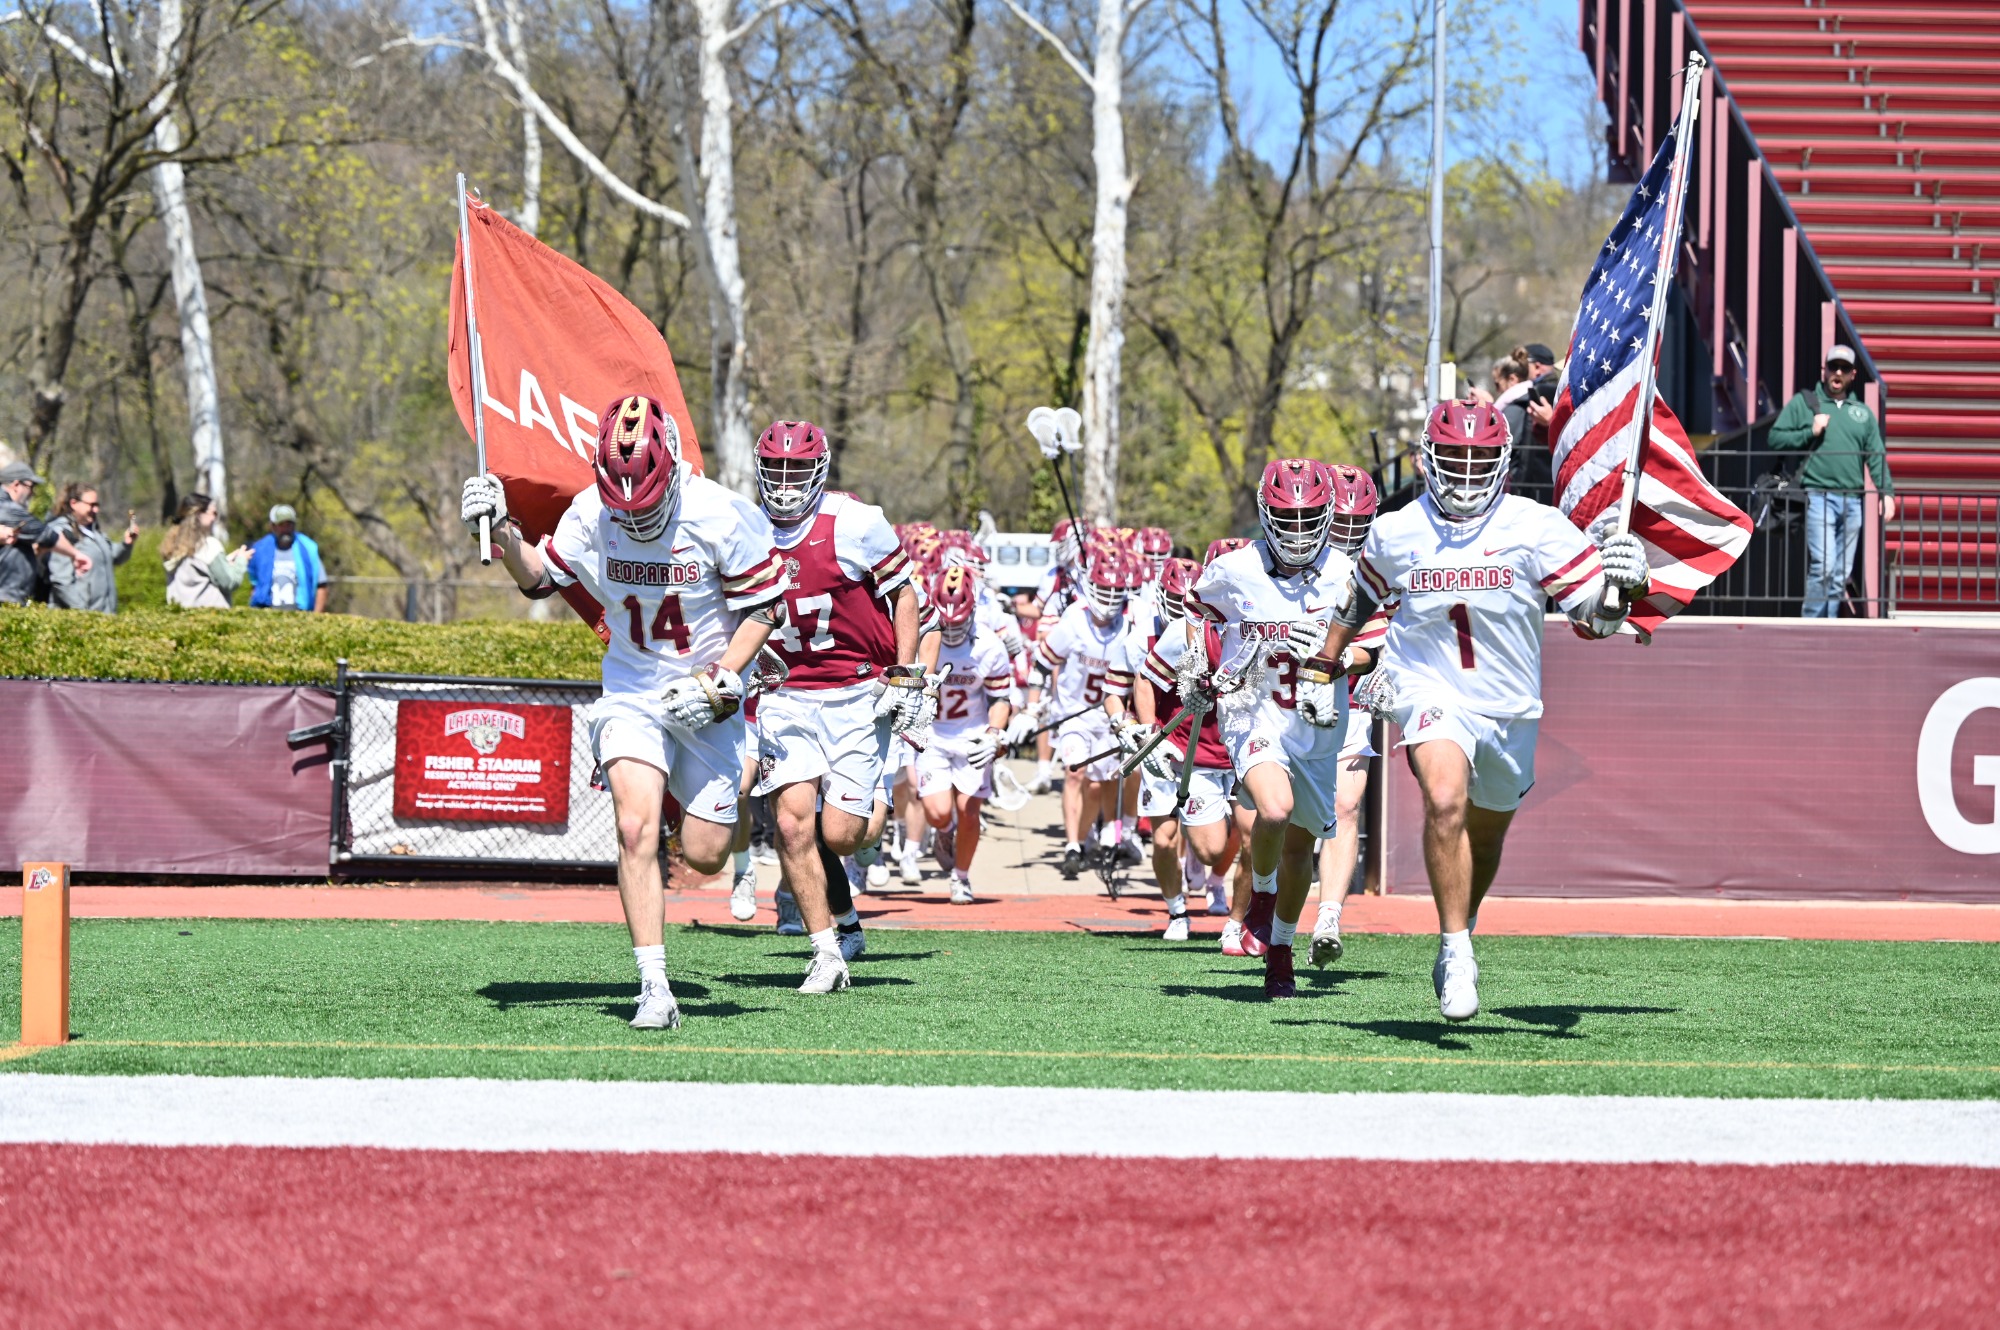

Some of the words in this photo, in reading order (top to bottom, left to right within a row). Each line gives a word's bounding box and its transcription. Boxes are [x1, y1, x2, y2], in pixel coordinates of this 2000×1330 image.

[607, 557, 700, 586] LEOPARDS
[1409, 567, 1514, 592] LEOPARDS
[622, 593, 692, 656] 14
[1240, 620, 1327, 641] LEOPA
[1448, 601, 1477, 671] 1
[1084, 673, 1104, 704] 5
[1266, 649, 1300, 709] 3
[936, 689, 968, 719] 2
[448, 712, 521, 734] LAFAYETTE
[424, 770, 466, 780] RESERVED
[468, 772, 486, 781] FOR
[487, 772, 541, 783] AUTHORIZED
[425, 756, 474, 771] FISHER
[477, 758, 541, 773] STADIUM
[1917, 677, 2000, 855] G
[447, 781, 492, 790] ACTIVITIES
[493, 782, 517, 791] ONLY
